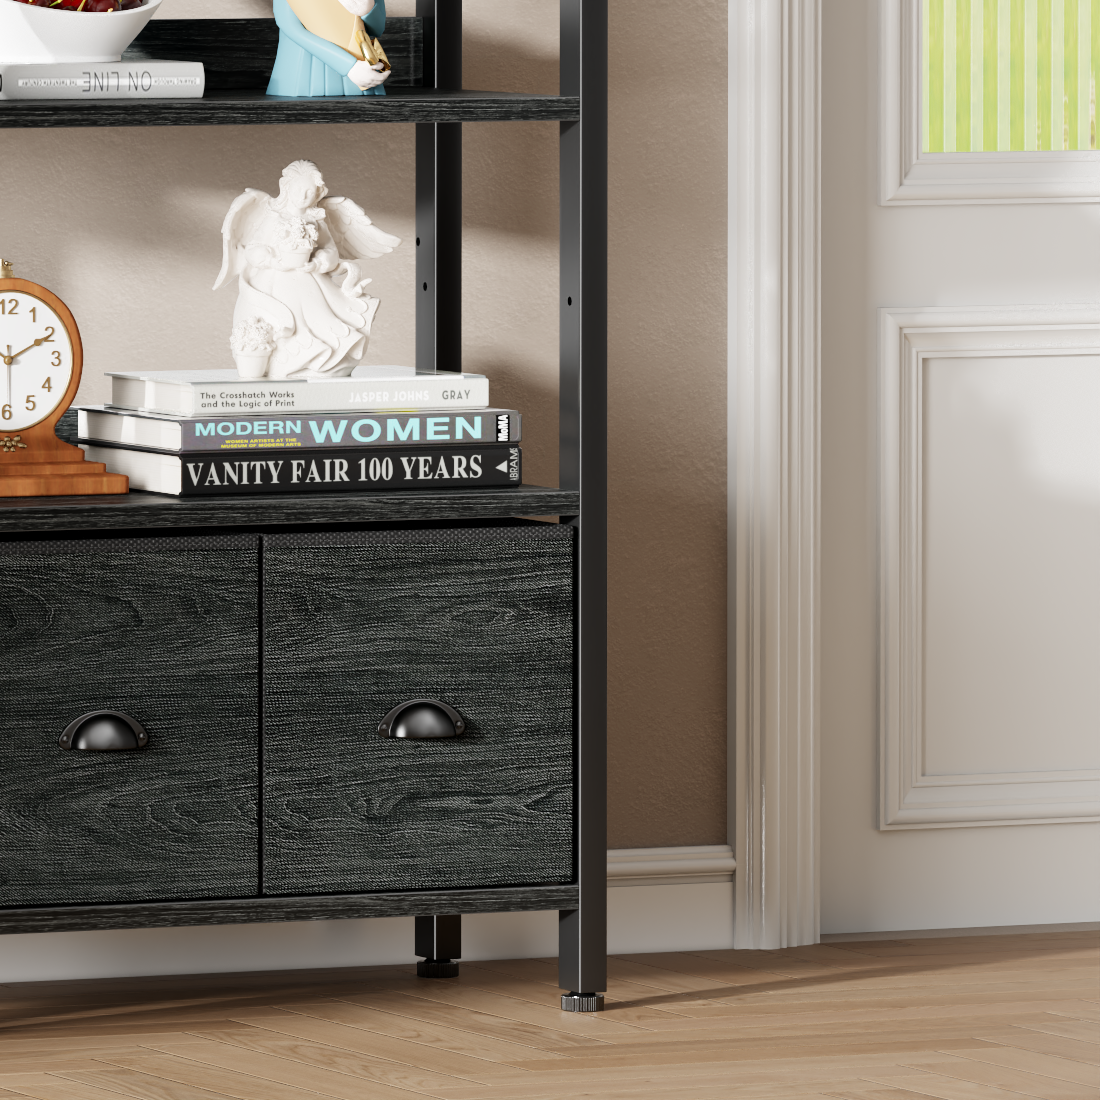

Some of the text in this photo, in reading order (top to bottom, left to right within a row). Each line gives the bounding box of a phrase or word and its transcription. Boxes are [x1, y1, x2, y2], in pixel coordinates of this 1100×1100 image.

[82, 71, 152, 93] ON LINE
[29, 306, 36, 323] 1
[43, 326, 55, 342] 2
[51, 350, 62, 367] 3
[41, 376, 52, 393] 4
[25, 395, 36, 411] 5
[200, 390, 295, 400] The Crosshatch Works
[348, 389, 471, 403] JASPER JOHNS GRAY
[1, 404, 13, 421] 6
[201, 399, 295, 409] and the Logic of Print
[194, 416, 483, 445] MODERN WOMEN
[497, 414, 509, 442] MoMA
[186, 453, 483, 488] VANITY FAIR 100 YEARS
